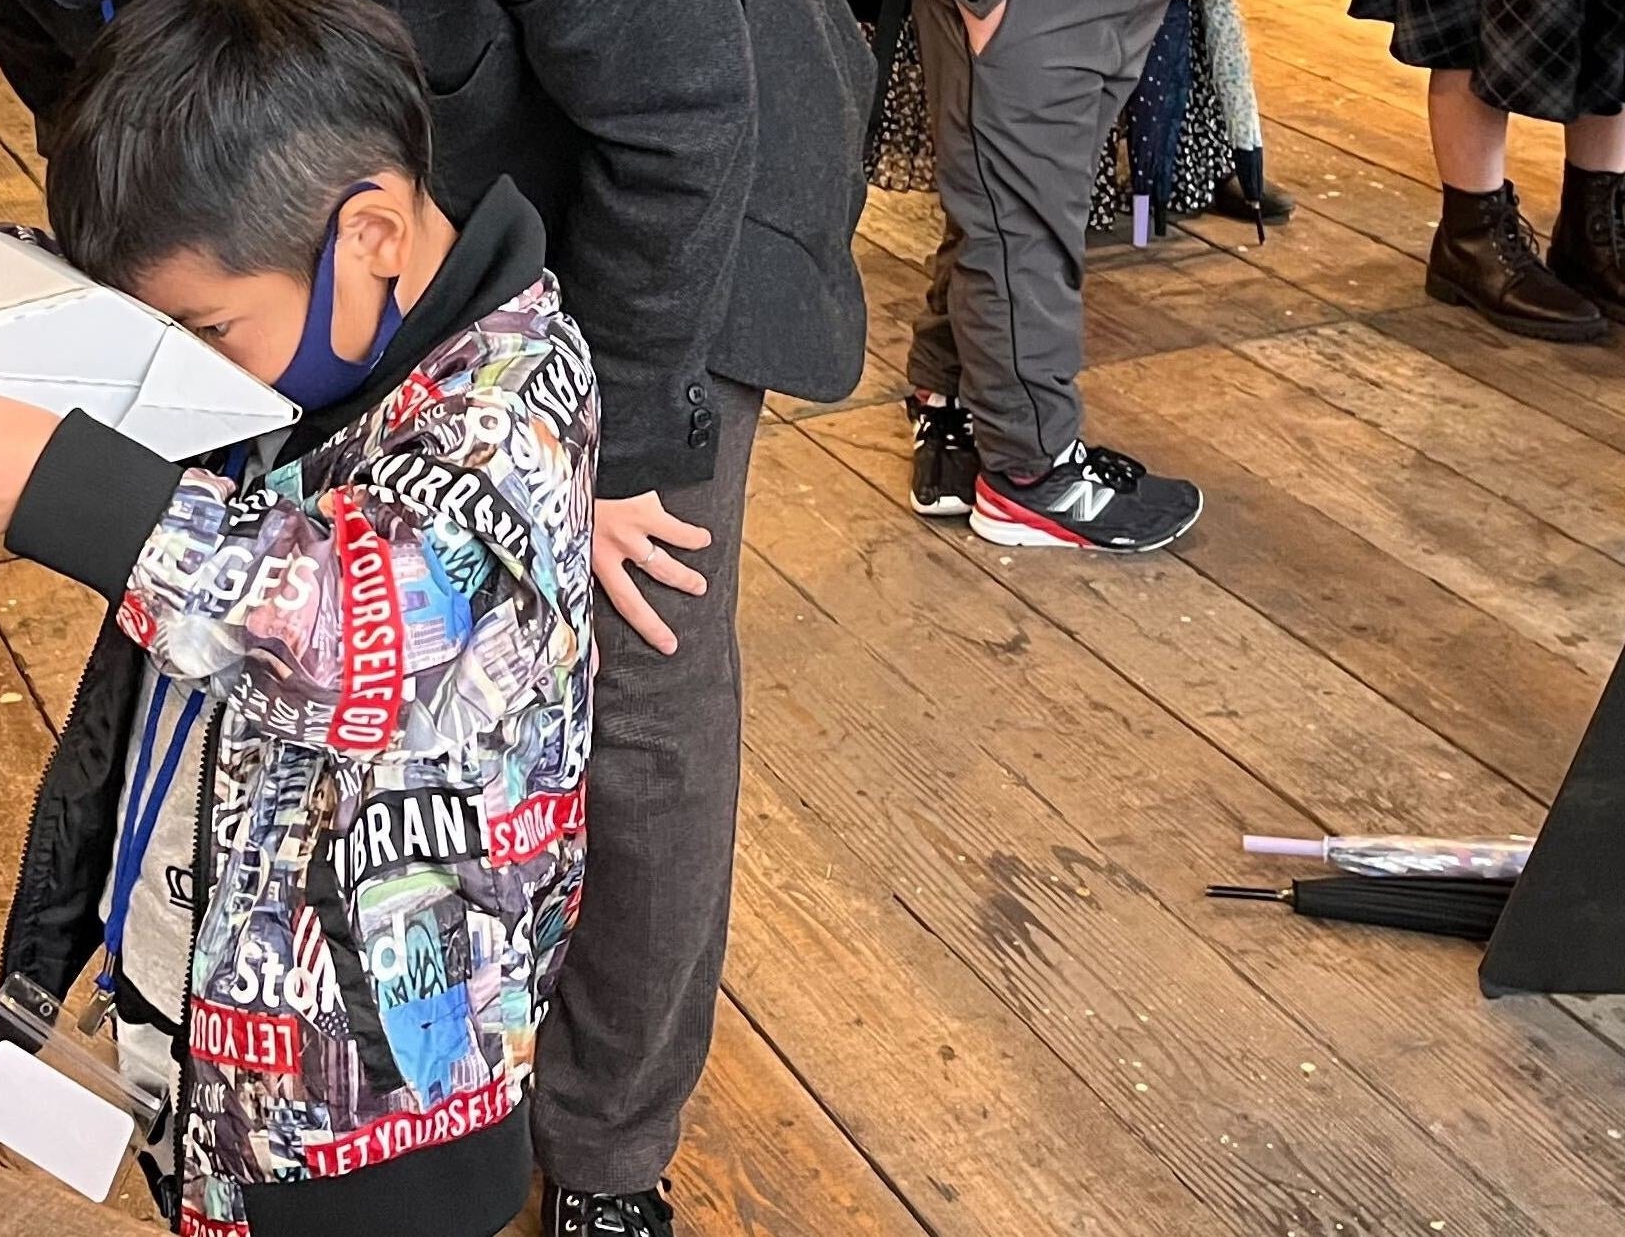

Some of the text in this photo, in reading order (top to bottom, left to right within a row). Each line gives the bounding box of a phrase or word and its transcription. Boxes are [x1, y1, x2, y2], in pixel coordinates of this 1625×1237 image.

[347, 531, 397, 701] YOURSELF
[337, 707, 389, 743] GO
[494, 799, 558, 858] YOURS
[189, 1012, 294, 1068] LET YOU
[316, 1081, 510, 1178] LET YOURSELF
